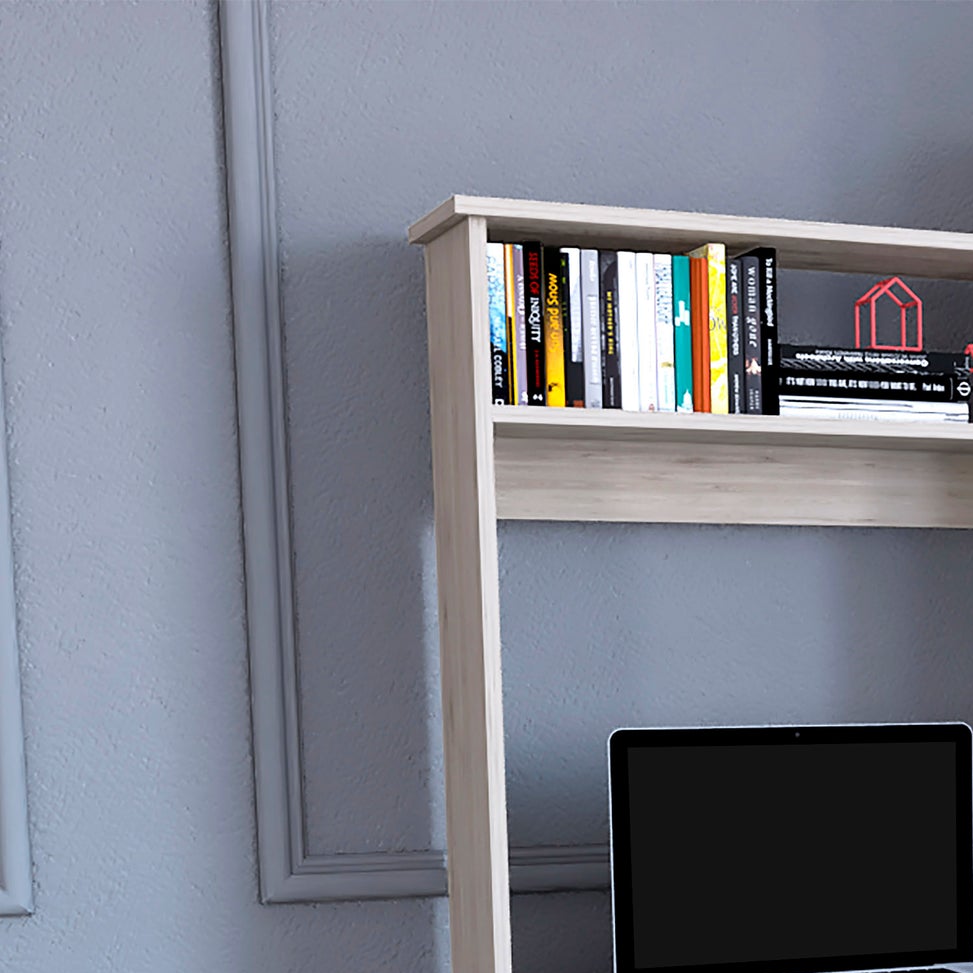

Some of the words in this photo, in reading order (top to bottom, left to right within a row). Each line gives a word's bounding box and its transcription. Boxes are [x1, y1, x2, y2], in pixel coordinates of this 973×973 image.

[529, 252, 539, 279] SEEDS
[765, 258, 773, 267] To
[530, 281, 539, 295] OF
[547, 272, 560, 305] Snow
[746, 266, 757, 313] woman
[529, 296, 541, 343] INIQUITY
[546, 307, 560, 331] and
[764, 285, 774, 327] Mockingbird
[746, 315, 758, 349] gone
[492, 354, 503, 389] COBLEY
[843, 355, 864, 363] with
